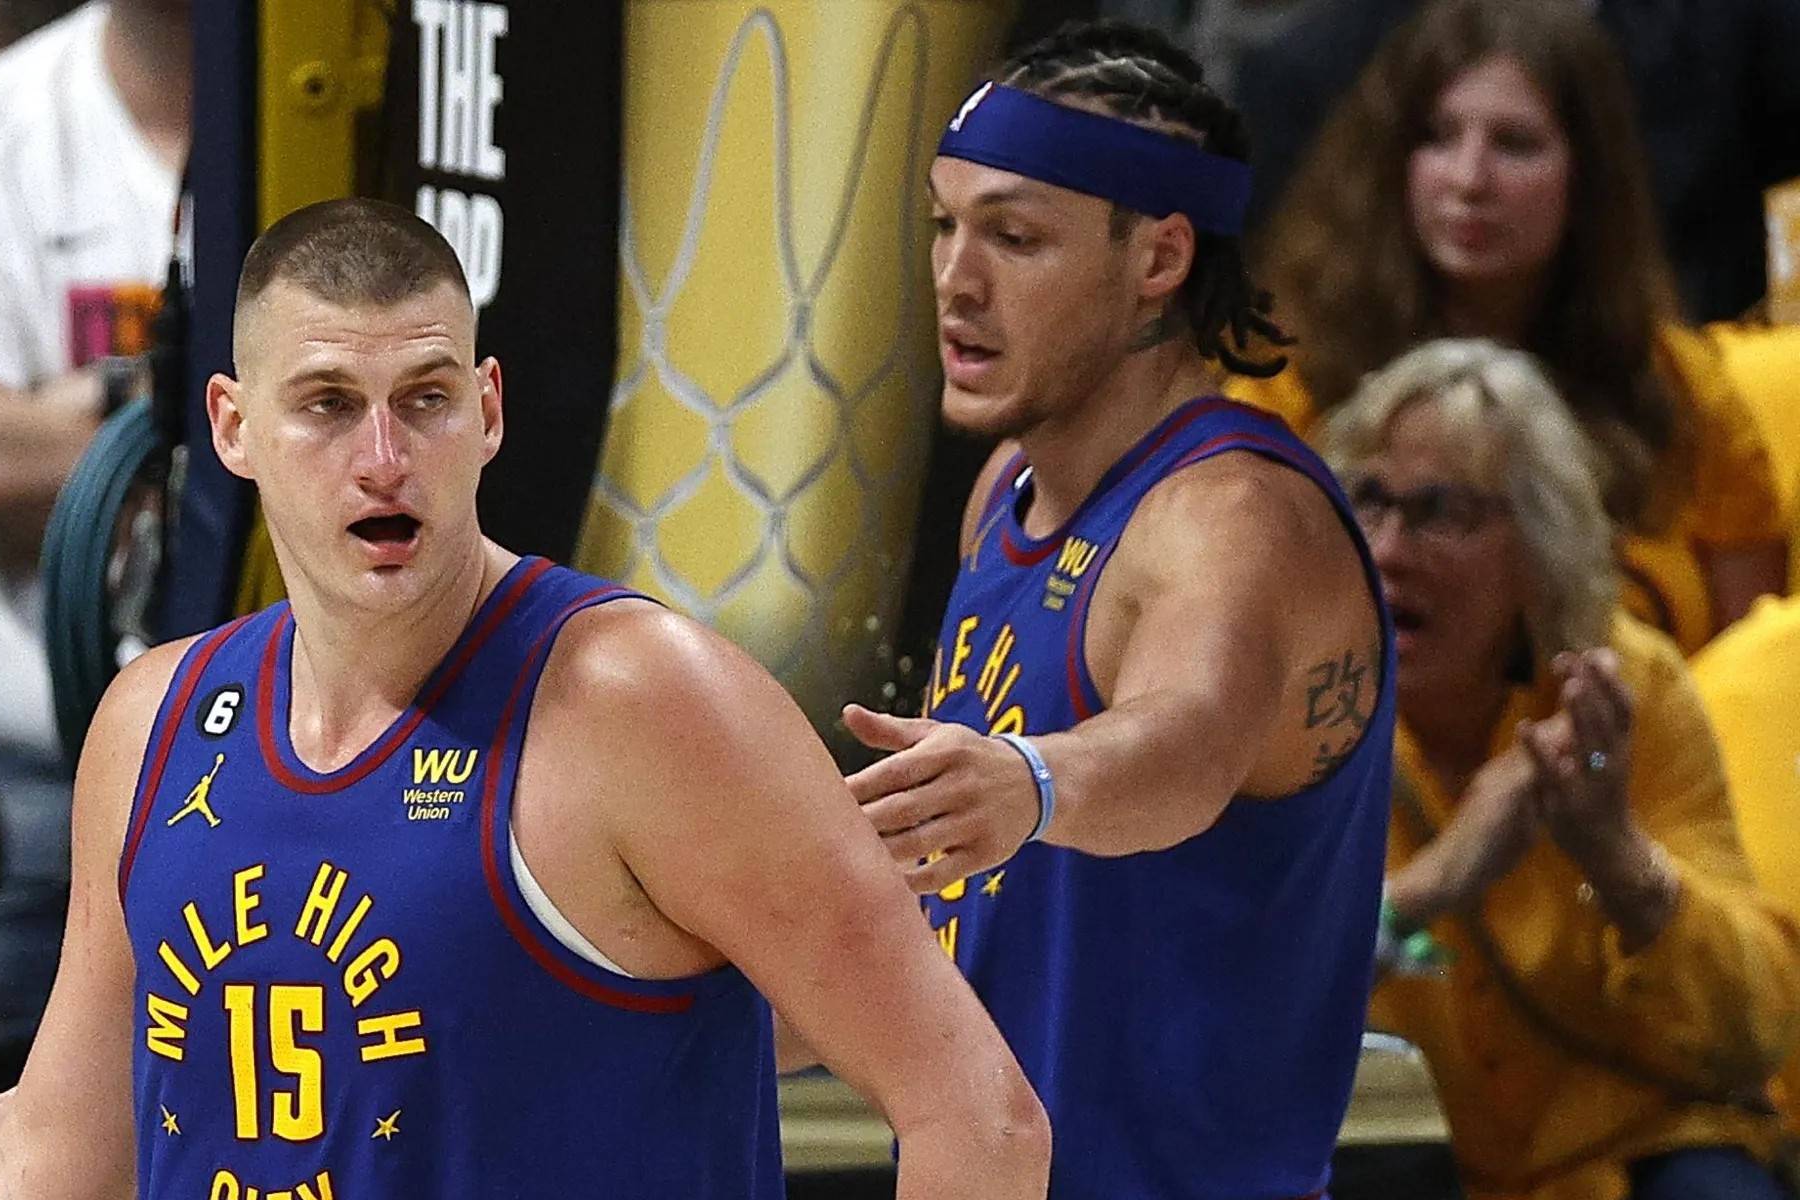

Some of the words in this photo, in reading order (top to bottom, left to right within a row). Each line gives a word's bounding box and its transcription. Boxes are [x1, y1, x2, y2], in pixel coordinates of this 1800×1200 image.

[411, 0, 509, 181] THE
[204, 692, 240, 735] 6
[413, 748, 479, 785] WU
[402, 788, 464, 804] Western
[407, 804, 450, 820] Union
[146, 863, 270, 1063] MILE
[295, 861, 427, 1063] HIGH
[223, 983, 325, 1142] 15
